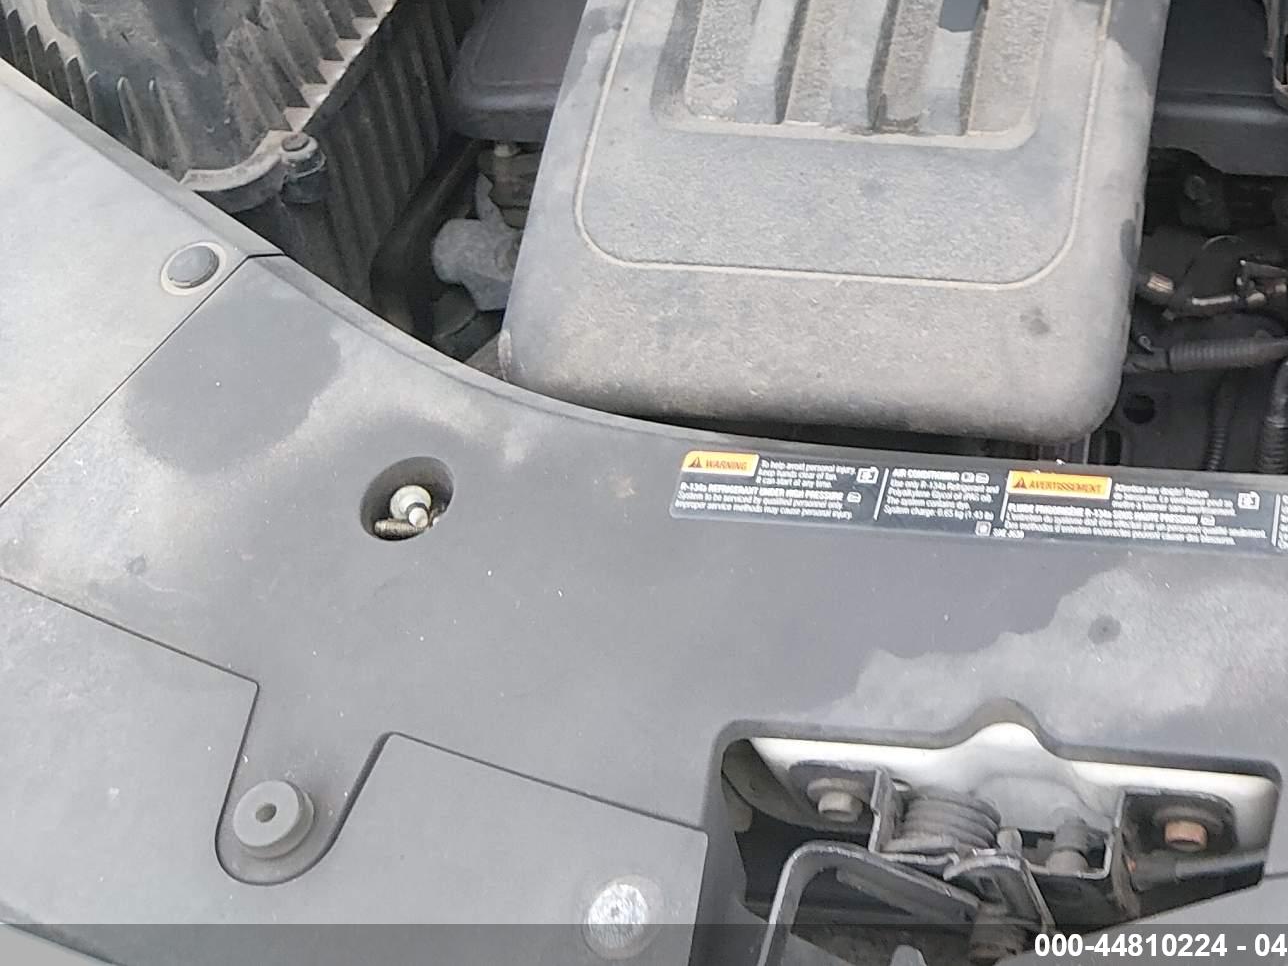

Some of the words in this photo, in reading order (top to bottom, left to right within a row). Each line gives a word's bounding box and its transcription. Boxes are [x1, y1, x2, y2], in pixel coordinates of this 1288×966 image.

[705, 460, 748, 470] WARNING
[805, 463, 836, 473] personal
[892, 468, 907, 478] AIR
[907, 469, 960, 481] CONDITIONING
[708, 484, 759, 495] REFRIGERANT
[759, 488, 785, 497] UNDER
[805, 491, 844, 501] PRESSURE
[677, 492, 704, 501] System
[723, 494, 752, 504] serviced
[763, 497, 792, 506] qualified
[793, 499, 827, 509] personnel
[675, 500, 706, 510] Improper
[707, 502, 732, 511] service
[732, 504, 763, 514] methods
[763, 506, 779, 515] may
[780, 507, 801, 516] cause
[801, 509, 832, 518] personal
[883, 506, 910, 515] System
